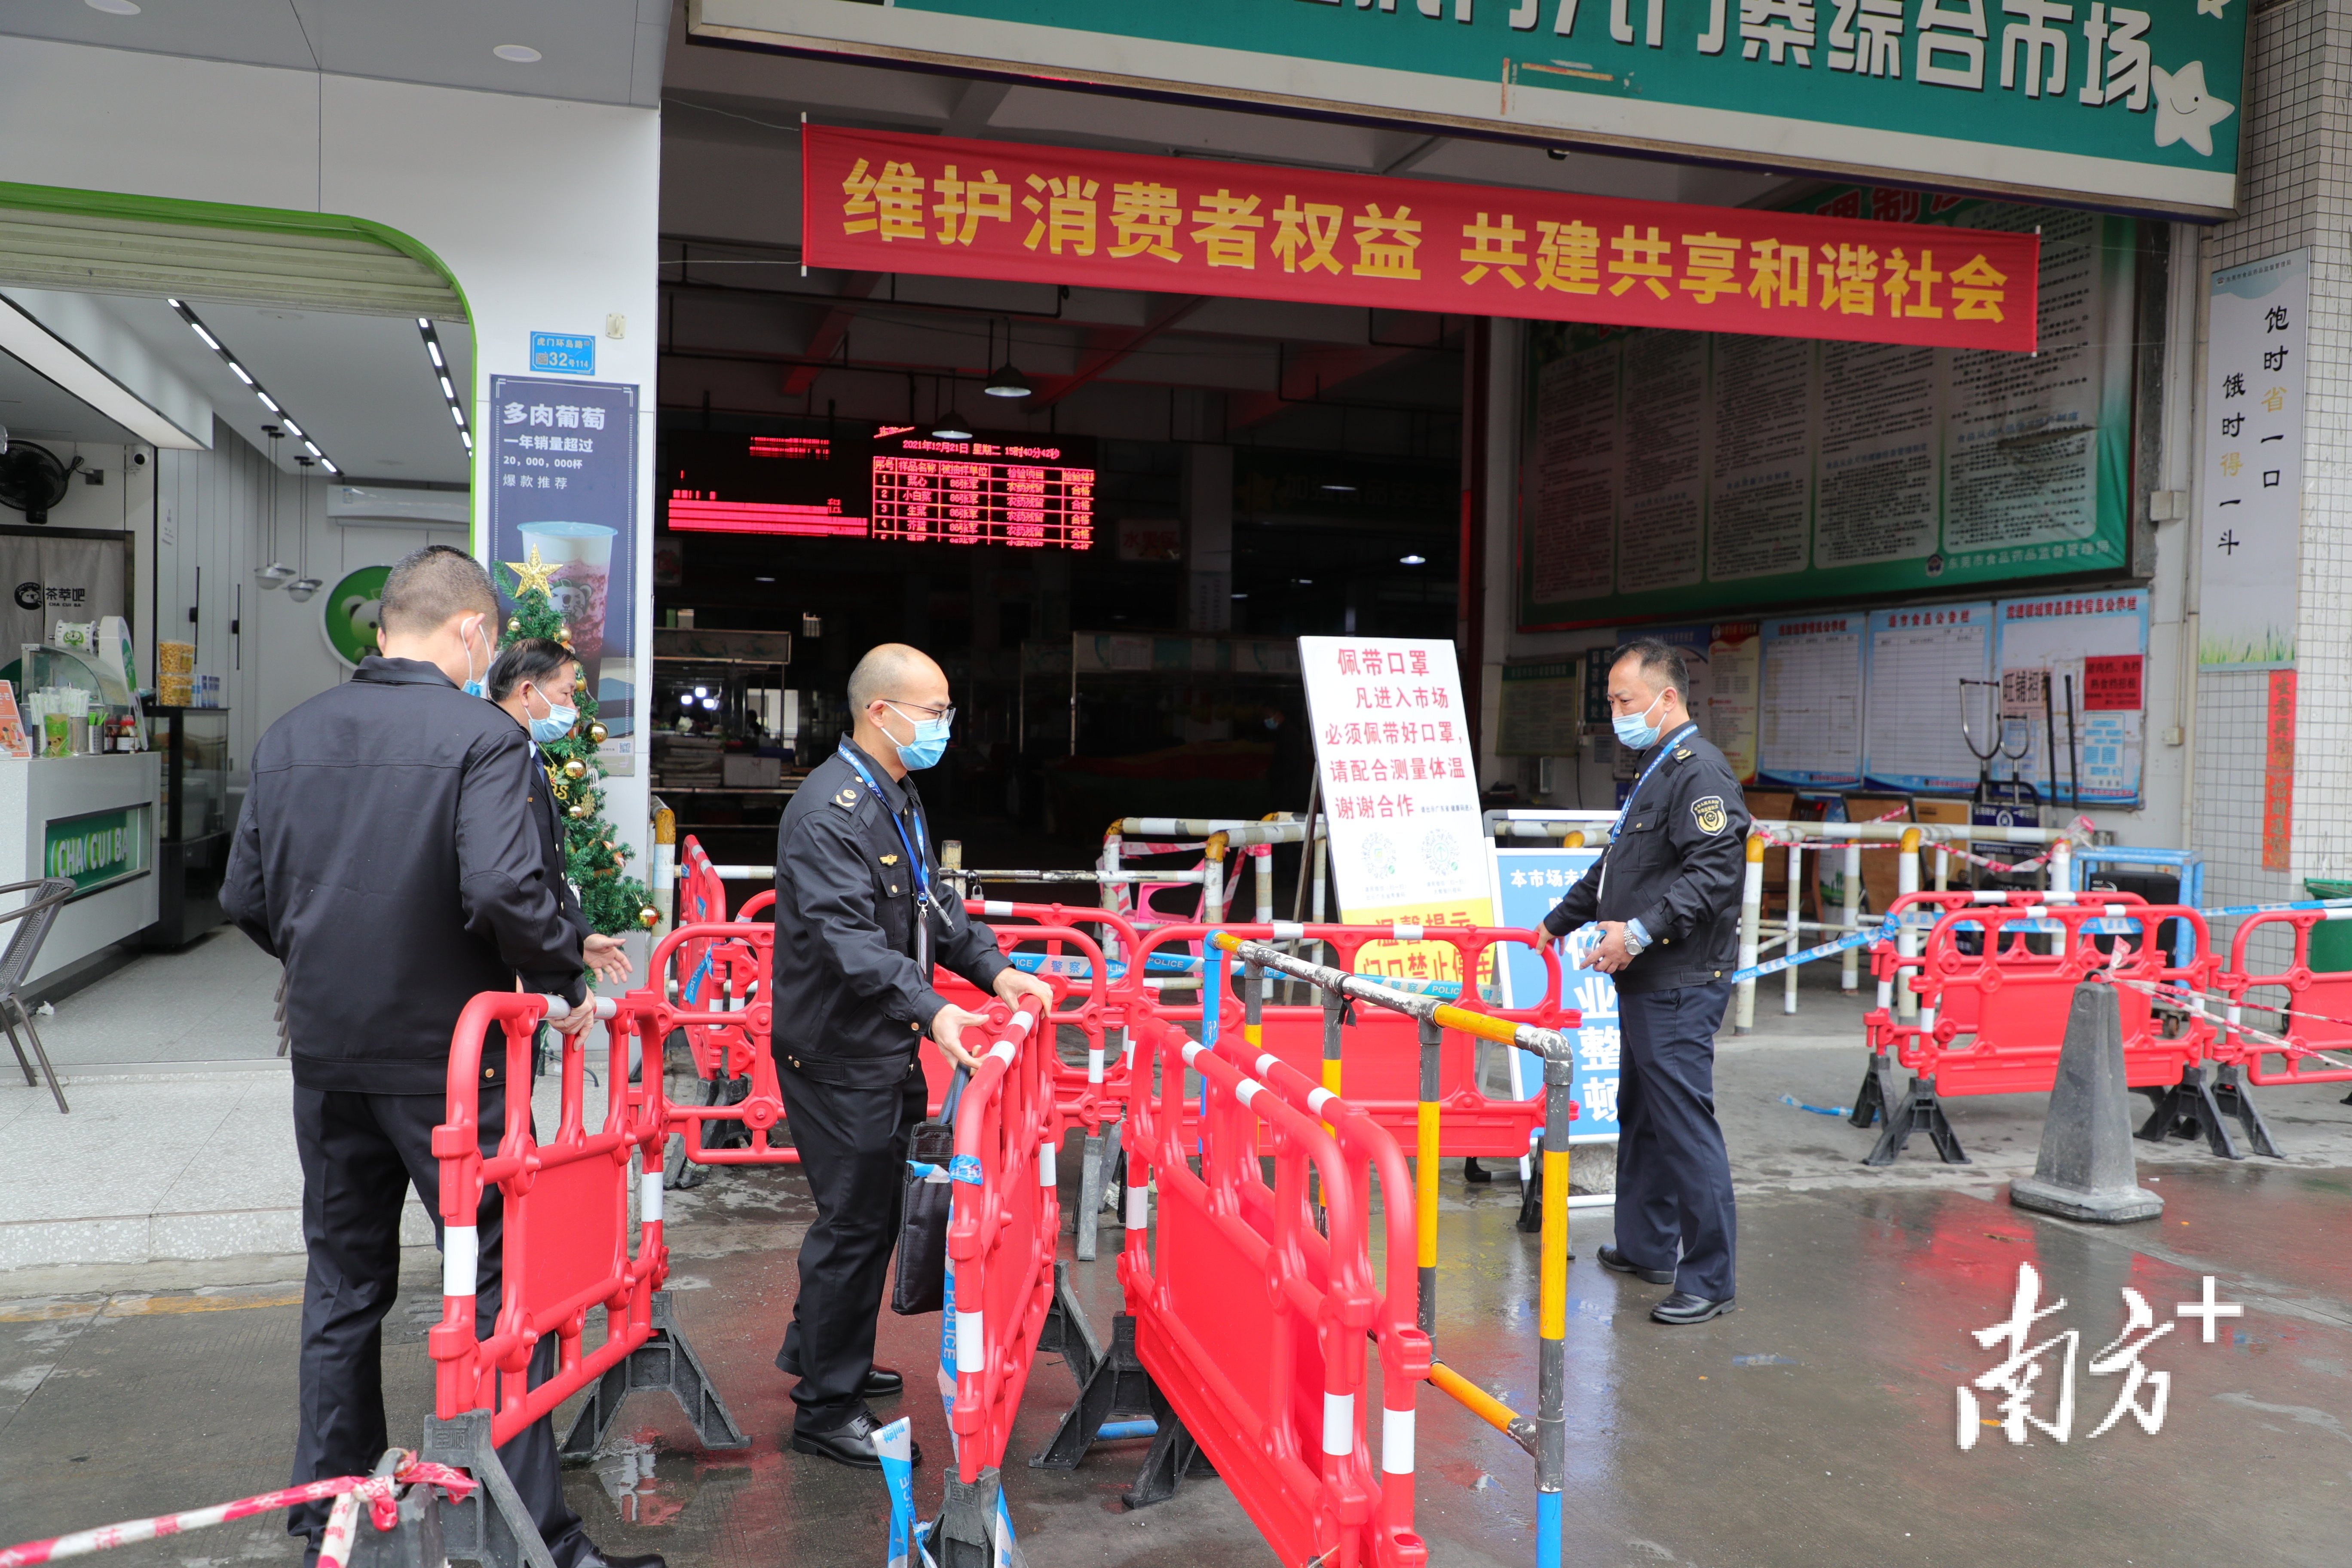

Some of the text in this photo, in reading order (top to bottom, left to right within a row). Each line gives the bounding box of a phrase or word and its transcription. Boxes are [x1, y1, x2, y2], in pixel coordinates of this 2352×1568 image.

[842, 157, 1423, 281] 维护消费者权益
[1459, 212, 2008, 324] 共建共享和谐社会
[536, 337, 583, 349] 虎门环岛路
[2261, 305, 2290, 488] 饱时省一口
[503, 401, 606, 430] 多肉葡萄
[504, 434, 593, 453] 一年销量超过
[903, 440, 1060, 459] 2021年12月21日 星期二 15时40分42秒
[875, 459, 895, 471] 序号
[898, 460, 936, 473] 样品名称
[1007, 467, 1044, 480] 检验项目
[2218, 373, 2246, 556] 饿时得一斗
[503, 474, 567, 490] 爆款推荐
[882, 475, 886, 483] 1
[907, 475, 927, 487] 菜心
[1007, 481, 1044, 494] 农药残留
[1072, 484, 1090, 496] 合格
[881, 489, 887, 498] 2
[903, 490, 931, 502] 小白菜
[1007, 496, 1044, 508] 农药残留
[1072, 499, 1090, 511] 合格
[881, 504, 887, 513] 3
[907, 505, 927, 517] 生菜
[1007, 511, 1044, 523] 农药残留
[1071, 514, 1090, 525] 合格
[881, 519, 887, 528] 4
[1007, 525, 1044, 537] 农药残留
[1071, 528, 1090, 540] 合格
[1123, 530, 1179, 548] 水果区
[1948, 539, 2109, 569] 东莞市食品药品监督管理局
[45, 587, 86, 602] 茶萃吧
[1338, 648, 1430, 676] 佩带口罩
[1356, 686, 1449, 709] 凡进入市场
[1325, 721, 1463, 745] 必须佩带好口罩，
[1329, 756, 1465, 783] 请配合测量体温
[1335, 793, 1415, 819] 谢谢合作
[57, 837, 84, 878] CHA
[90, 829, 111, 870] CUI
[1013, 957, 1033, 968] LICE
[1050, 960, 1081, 974] 警察
[1147, 957, 1184, 968] POLICE
[1390, 980, 1418, 993] 警察
[1432, 985, 1461, 995] POLIC
[943, 1289, 956, 1361] POLICE
[435, 1428, 468, 1450] 宝顺
[950, 1484, 975, 1505] 宝顺
